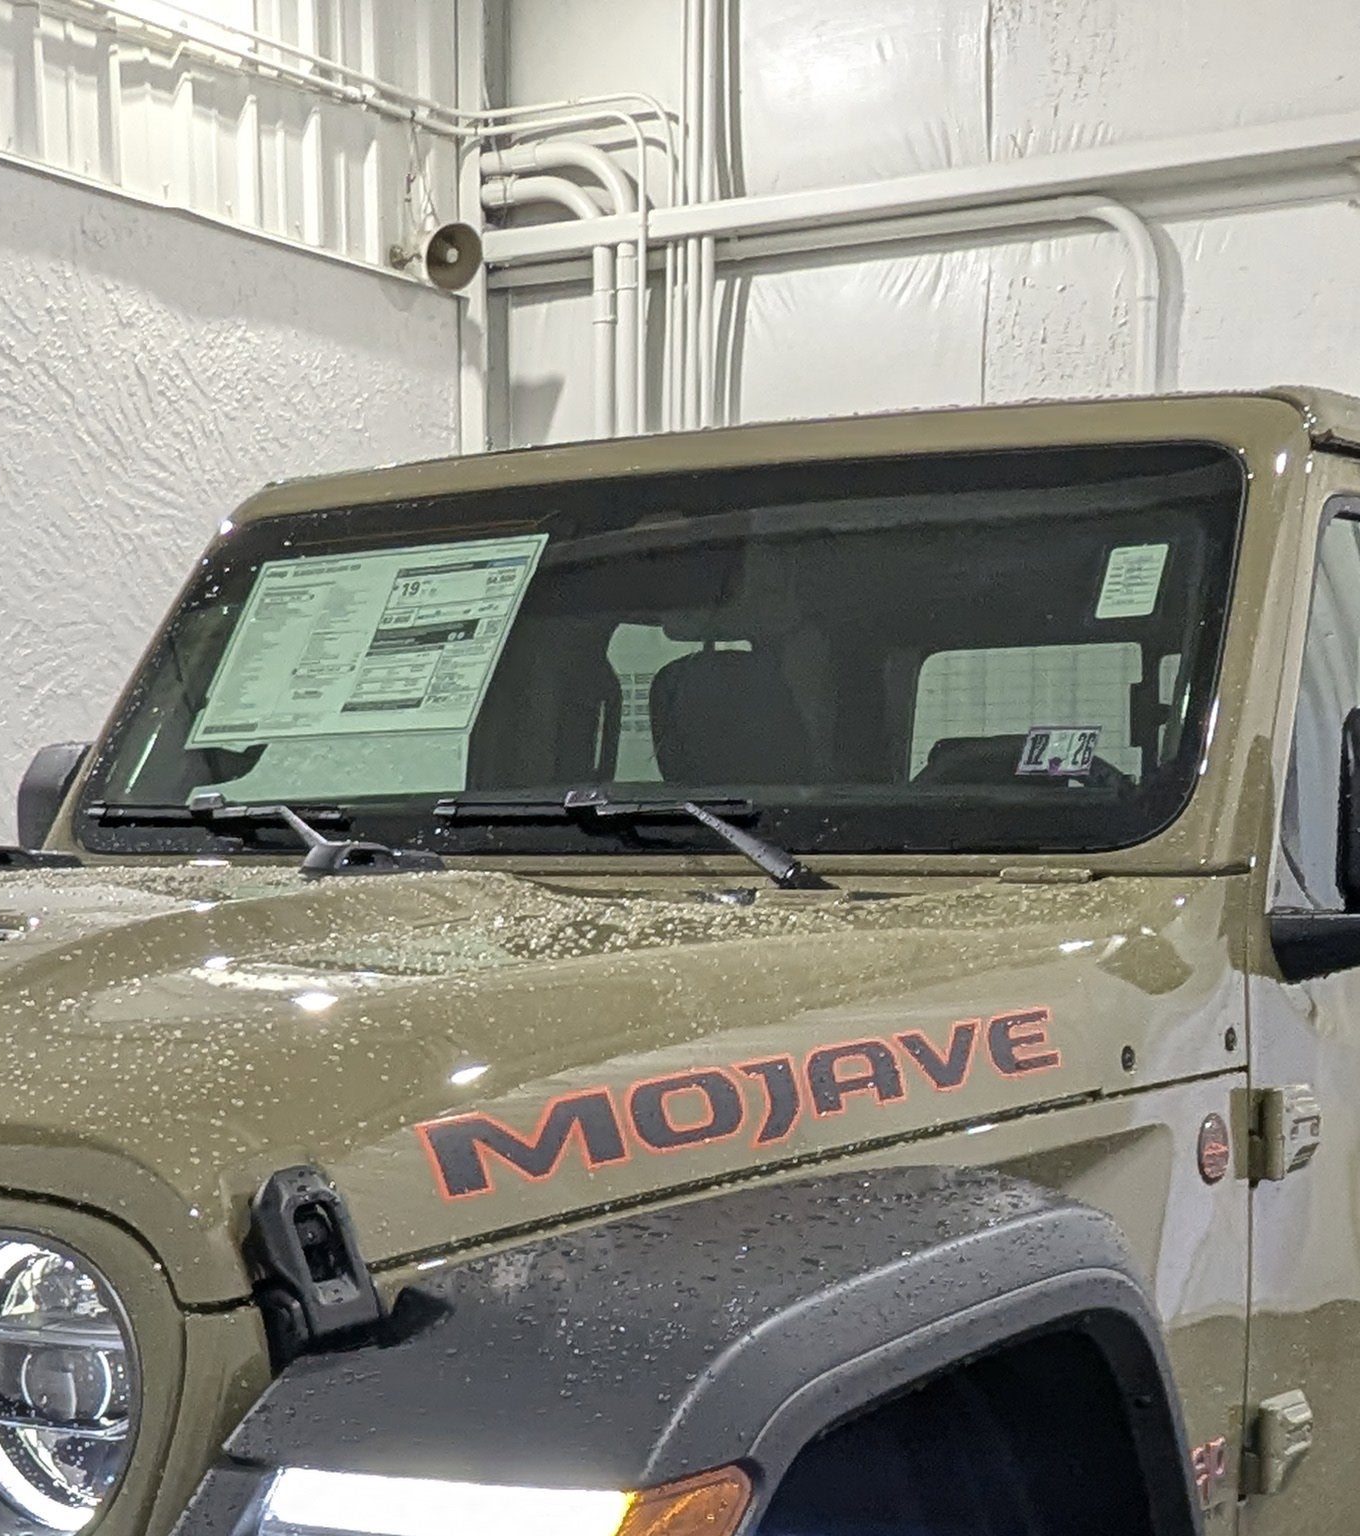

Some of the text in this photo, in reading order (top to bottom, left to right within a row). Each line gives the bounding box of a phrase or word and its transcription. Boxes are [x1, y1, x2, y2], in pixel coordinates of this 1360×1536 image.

[402, 581, 421, 597] 19
[1071, 733, 1096, 765] 26
[415, 1007, 1062, 1200] MOJAVE
